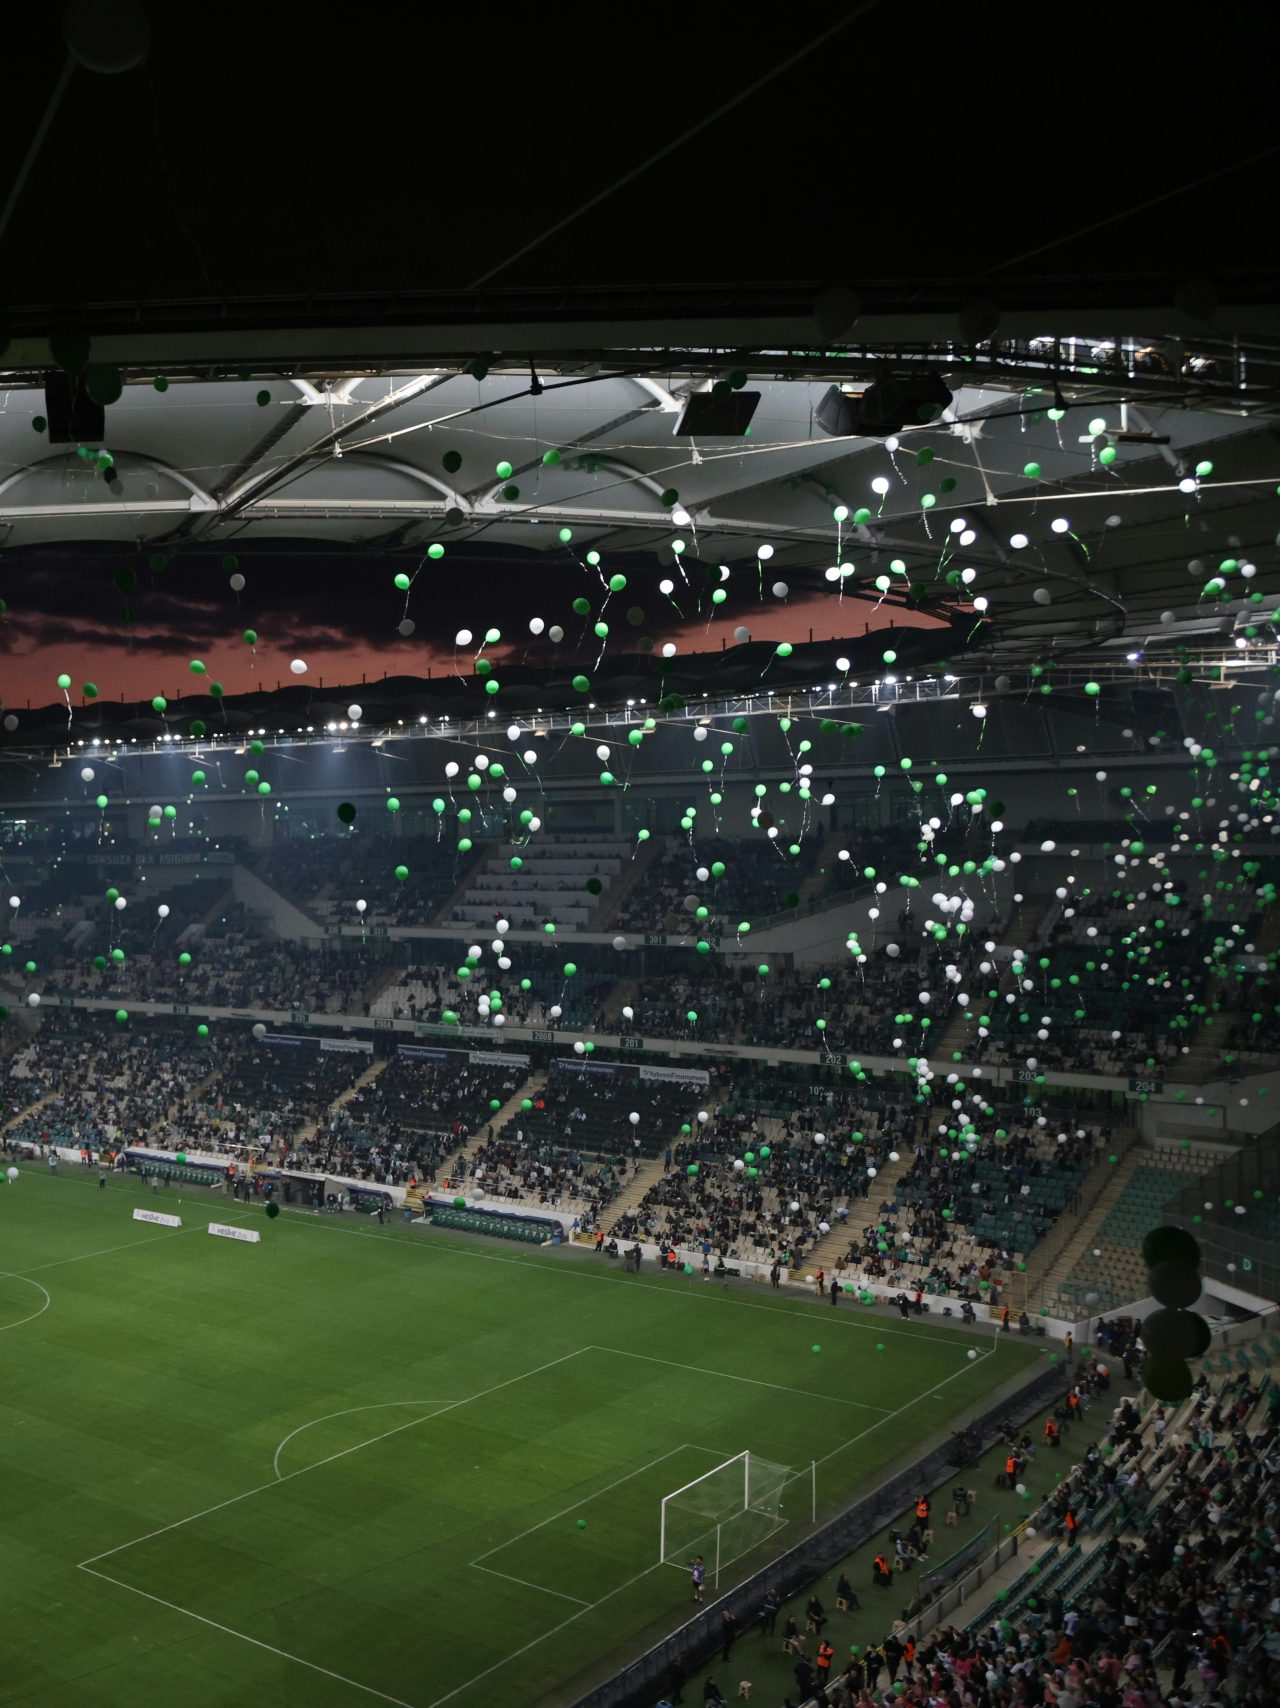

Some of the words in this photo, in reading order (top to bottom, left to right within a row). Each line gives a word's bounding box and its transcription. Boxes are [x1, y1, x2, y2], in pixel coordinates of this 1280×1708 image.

[534, 1032, 551, 1041] 200B
[625, 1038, 638, 1047] 201
[825, 1054, 842, 1065] 202
[1019, 1071, 1036, 1081] 203
[1136, 1081, 1155, 1091] 204
[1024, 1106, 1042, 1117] 103
[1243, 1258, 1252, 1271] D
